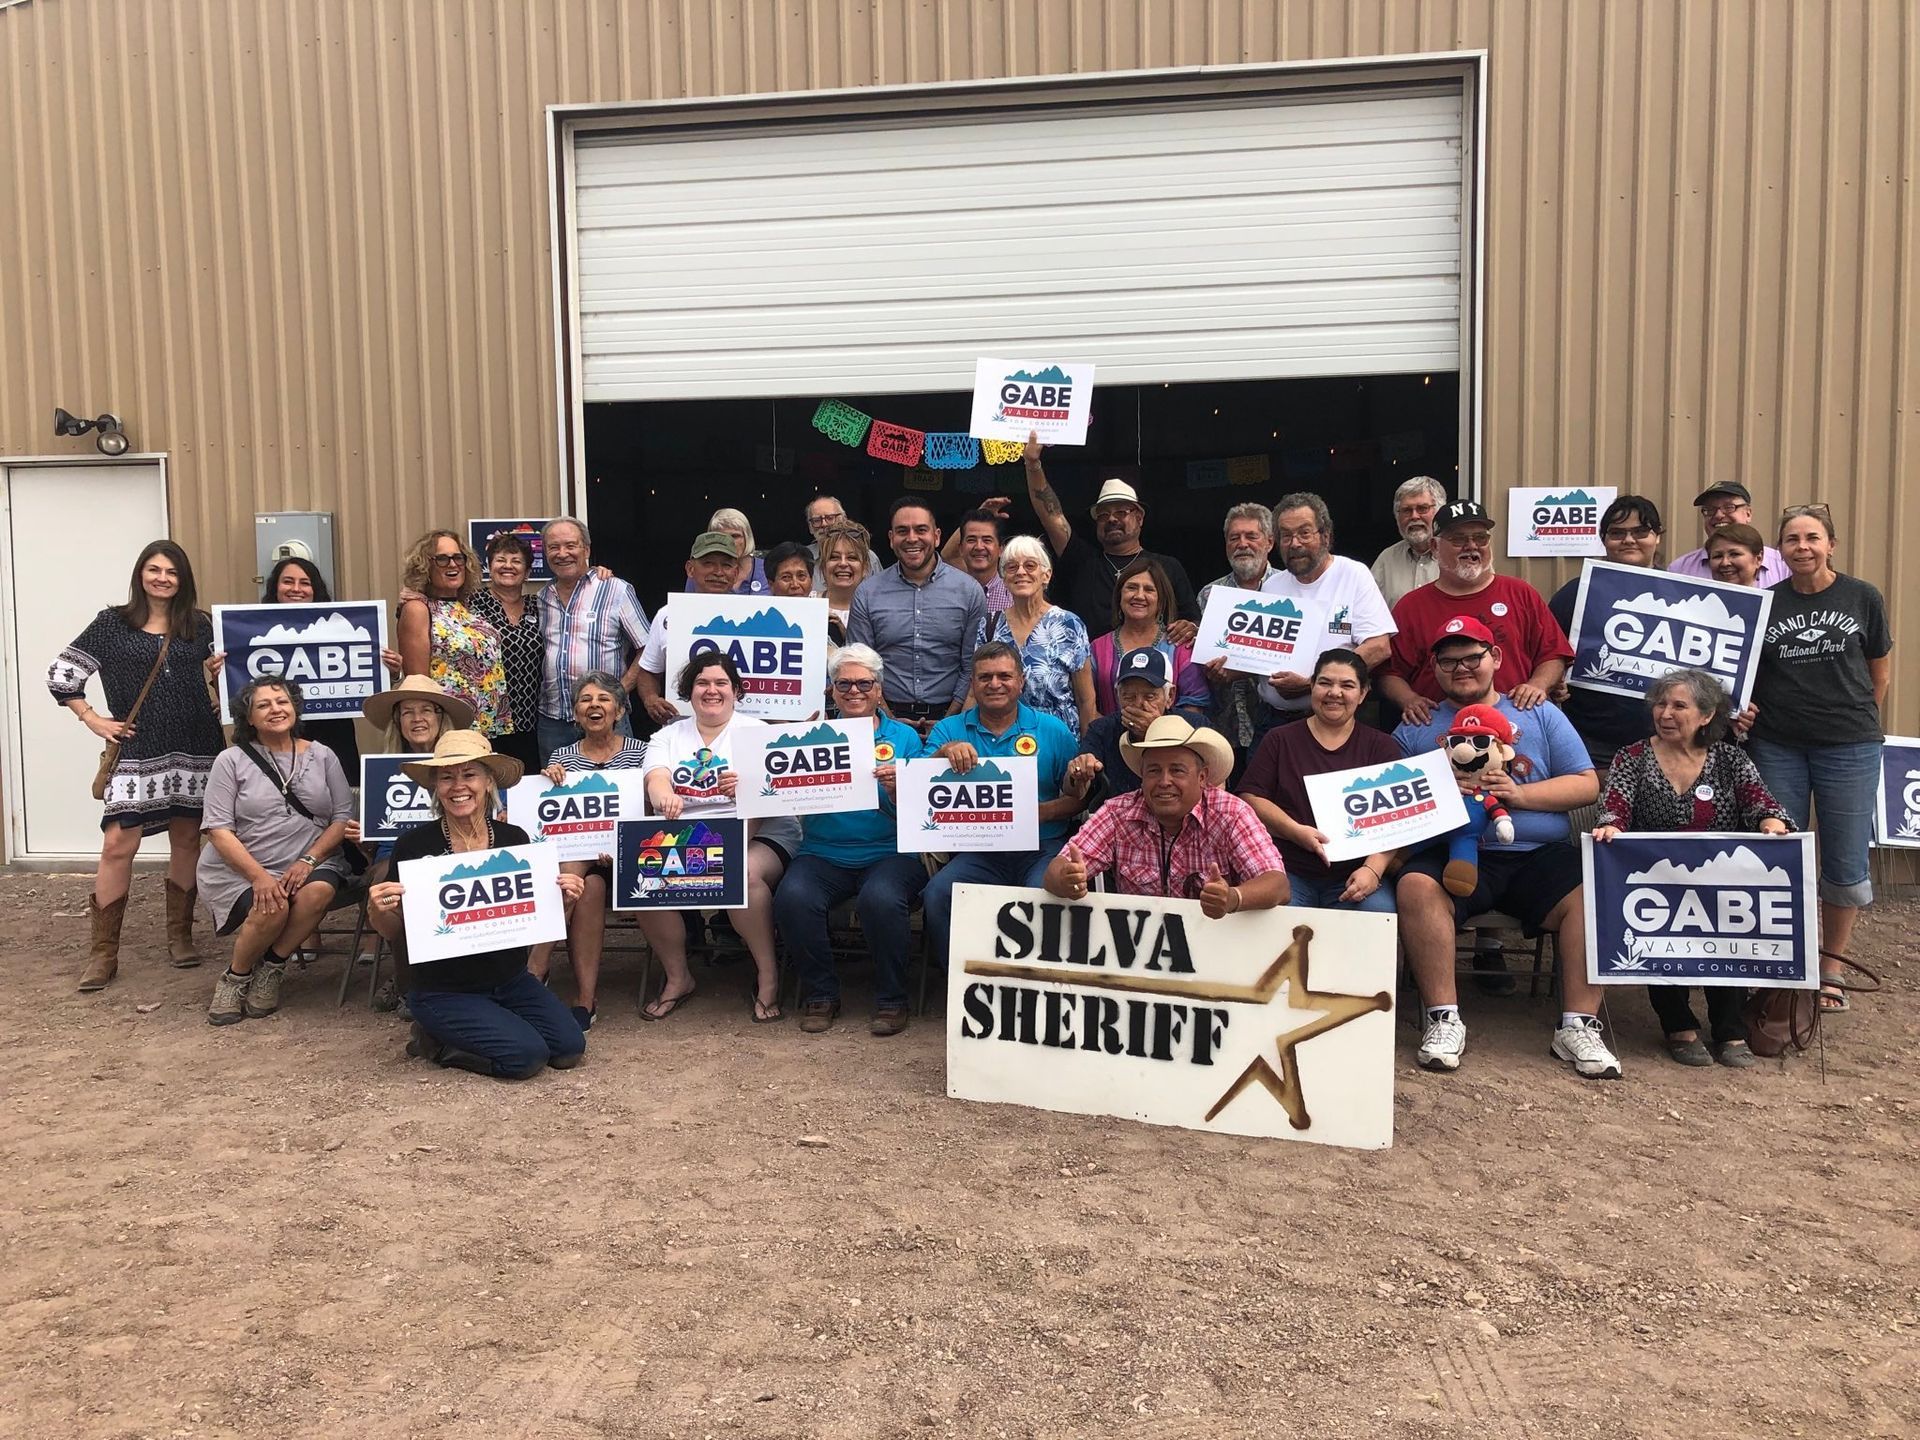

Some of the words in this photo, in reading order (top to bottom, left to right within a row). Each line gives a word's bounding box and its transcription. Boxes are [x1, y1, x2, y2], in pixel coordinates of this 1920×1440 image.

[1001, 384, 1072, 407] GABE
[1008, 408, 1064, 418] VASQUEZ
[881, 440, 910, 454] GABE
[1532, 507, 1597, 525] GABE
[1227, 611, 1302, 642] GABE
[1447, 620, 1460, 630] M
[1765, 614, 1806, 644] GRAND
[1810, 610, 1860, 635] CANYON
[1231, 636, 1290, 651] VASQUEZ
[1604, 613, 1745, 674] GABE
[1778, 641, 1819, 659] National
[1822, 638, 1846, 654] Park
[247, 645, 374, 680] GABE
[310, 684, 364, 696] QUEZ
[742, 681, 793, 692] QUEZ
[1617, 676, 1644, 687] FOR
[305, 700, 360, 710] CONGRE
[745, 697, 802, 706] ONGRESS
[1465, 718, 1478, 727] M
[765, 746, 851, 775] GABE
[777, 774, 845, 786] VASQUEZ
[386, 783, 432, 809] GA
[928, 784, 1013, 809] GABE
[1344, 777, 1433, 816] GABE
[538, 795, 620, 822] GABE
[939, 813, 1007, 821] VASQUEZ
[1360, 803, 1429, 827] VASQUEZ
[548, 822, 614, 833] VASQUEZ
[638, 847, 725, 876] GABE
[439, 872, 534, 910] GABE
[453, 905, 529, 922] VASQUEZ
[1622, 887, 1793, 935] GABE
[485, 916, 537, 928] CONGRESS
[995, 901, 1196, 974] SILVA
[1645, 940, 1780, 956] VASQUEZ
[1652, 963, 1684, 972] FOR
[1698, 963, 1795, 975] CONGRESS
[961, 982, 1230, 1067] SHERIFF
